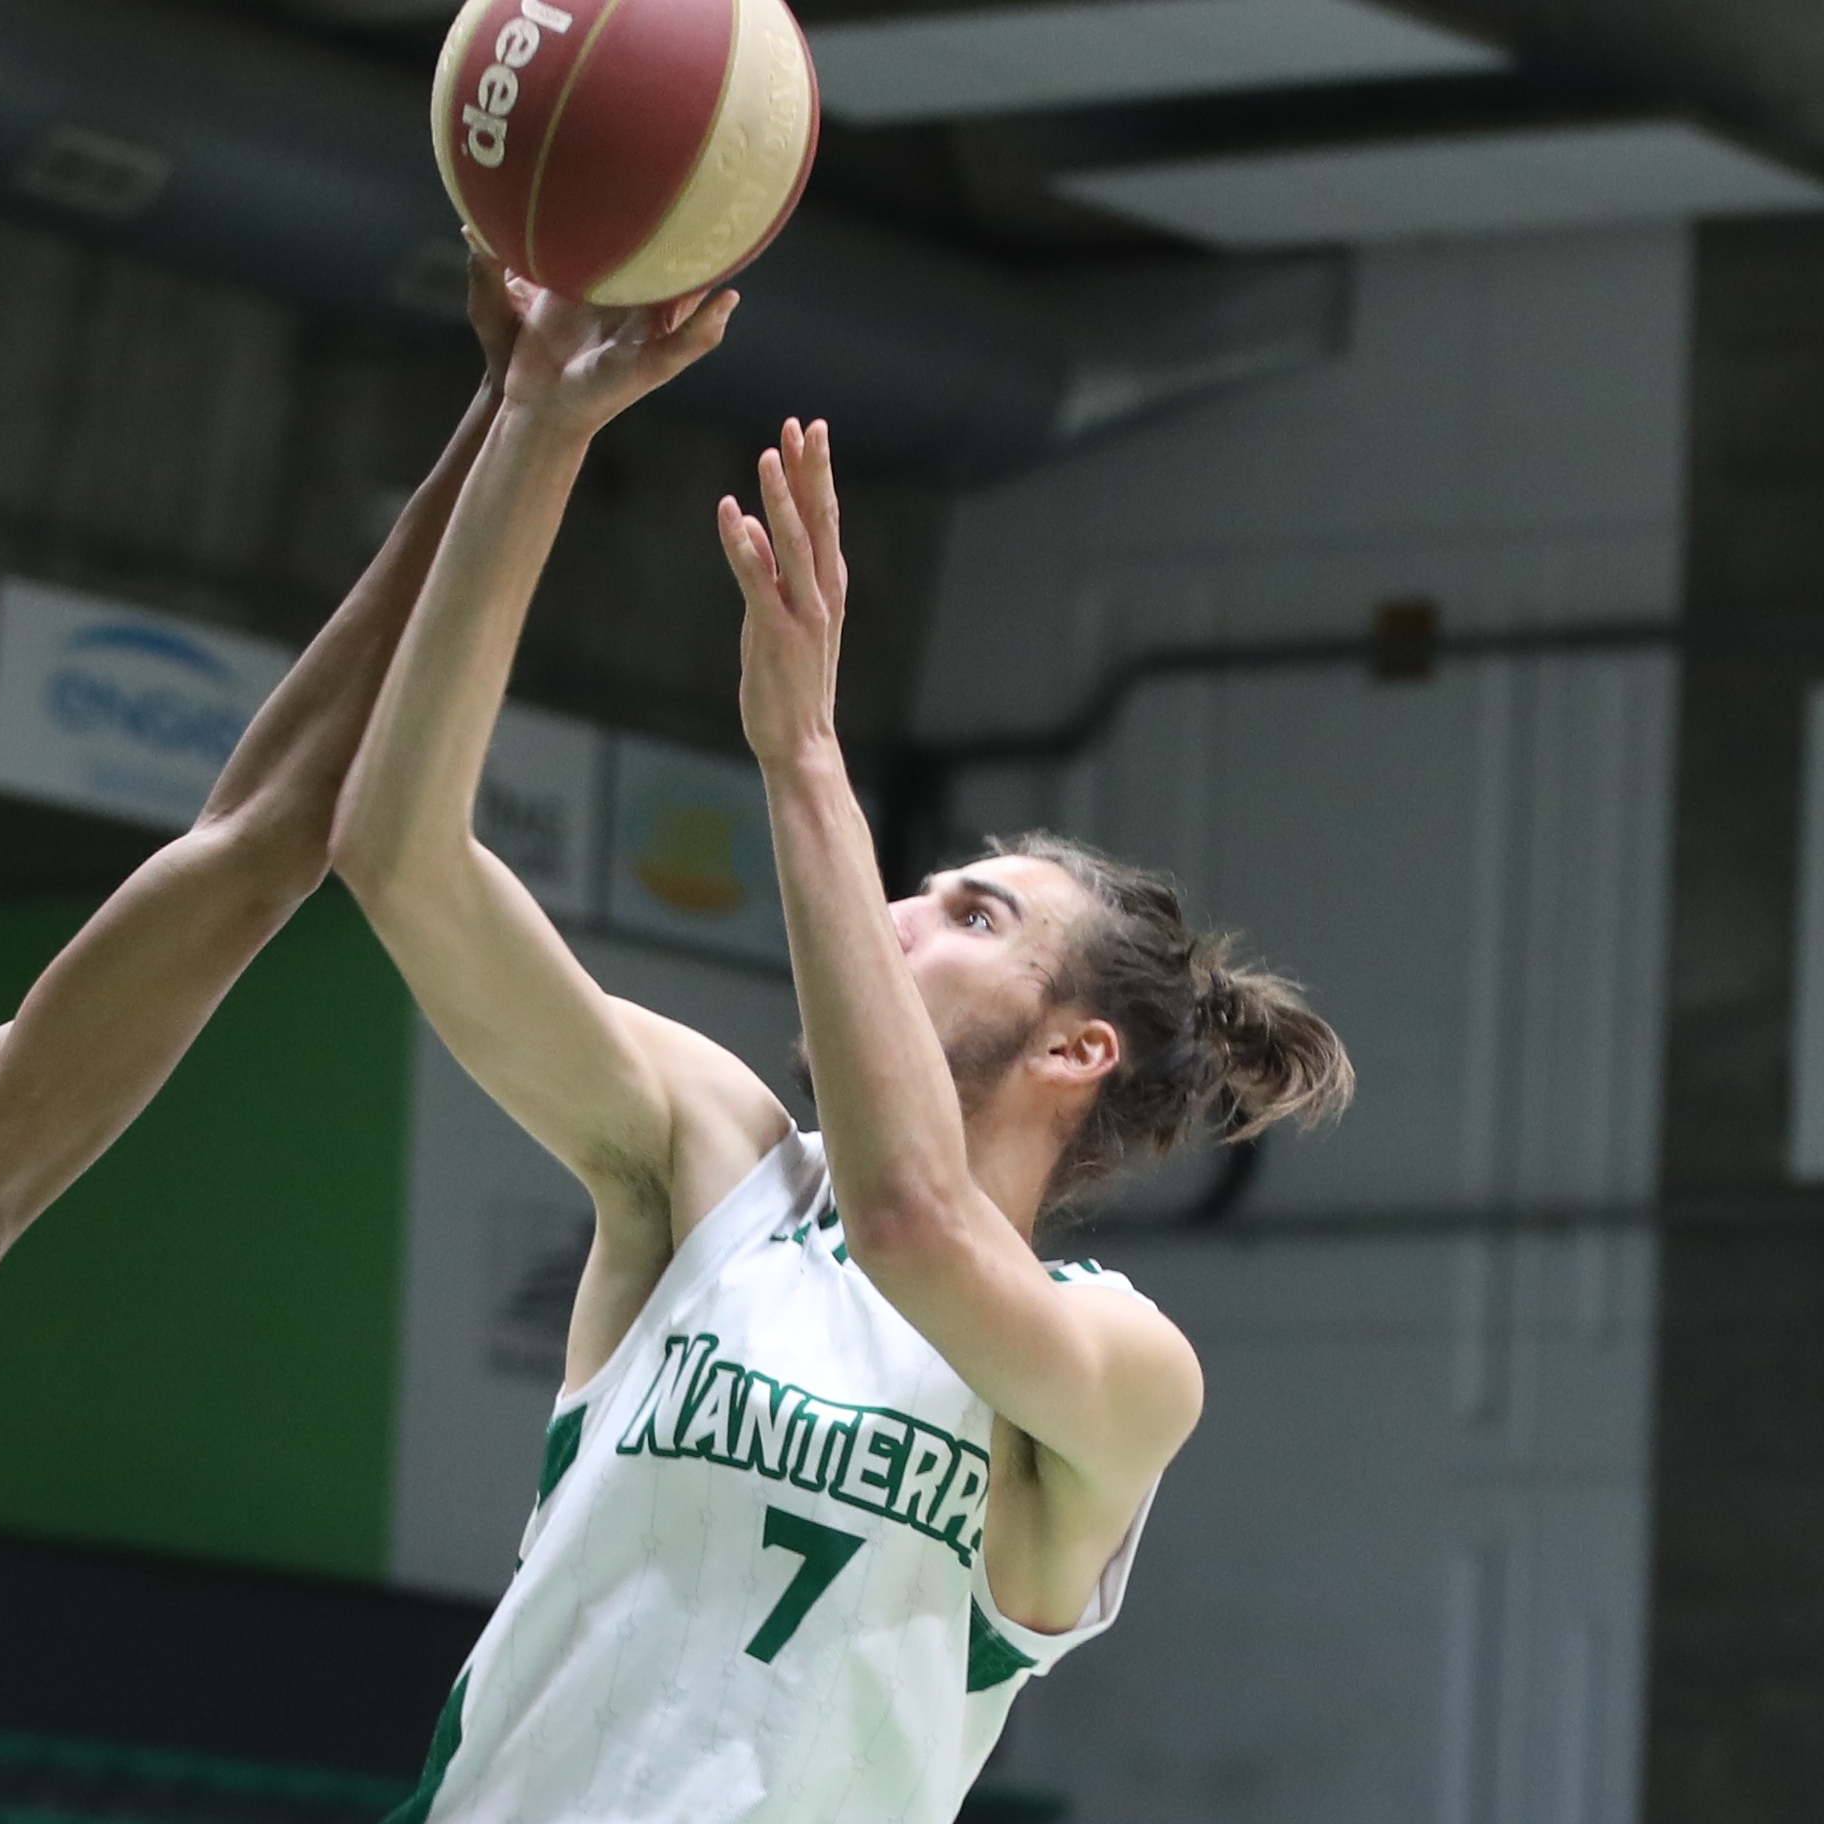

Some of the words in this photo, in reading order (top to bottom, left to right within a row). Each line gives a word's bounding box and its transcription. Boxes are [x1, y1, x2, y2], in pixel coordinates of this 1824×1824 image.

[462, 0, 573, 169] Jeep
[616, 1333, 990, 1568] NANTERR
[744, 1504, 867, 1664] 7
